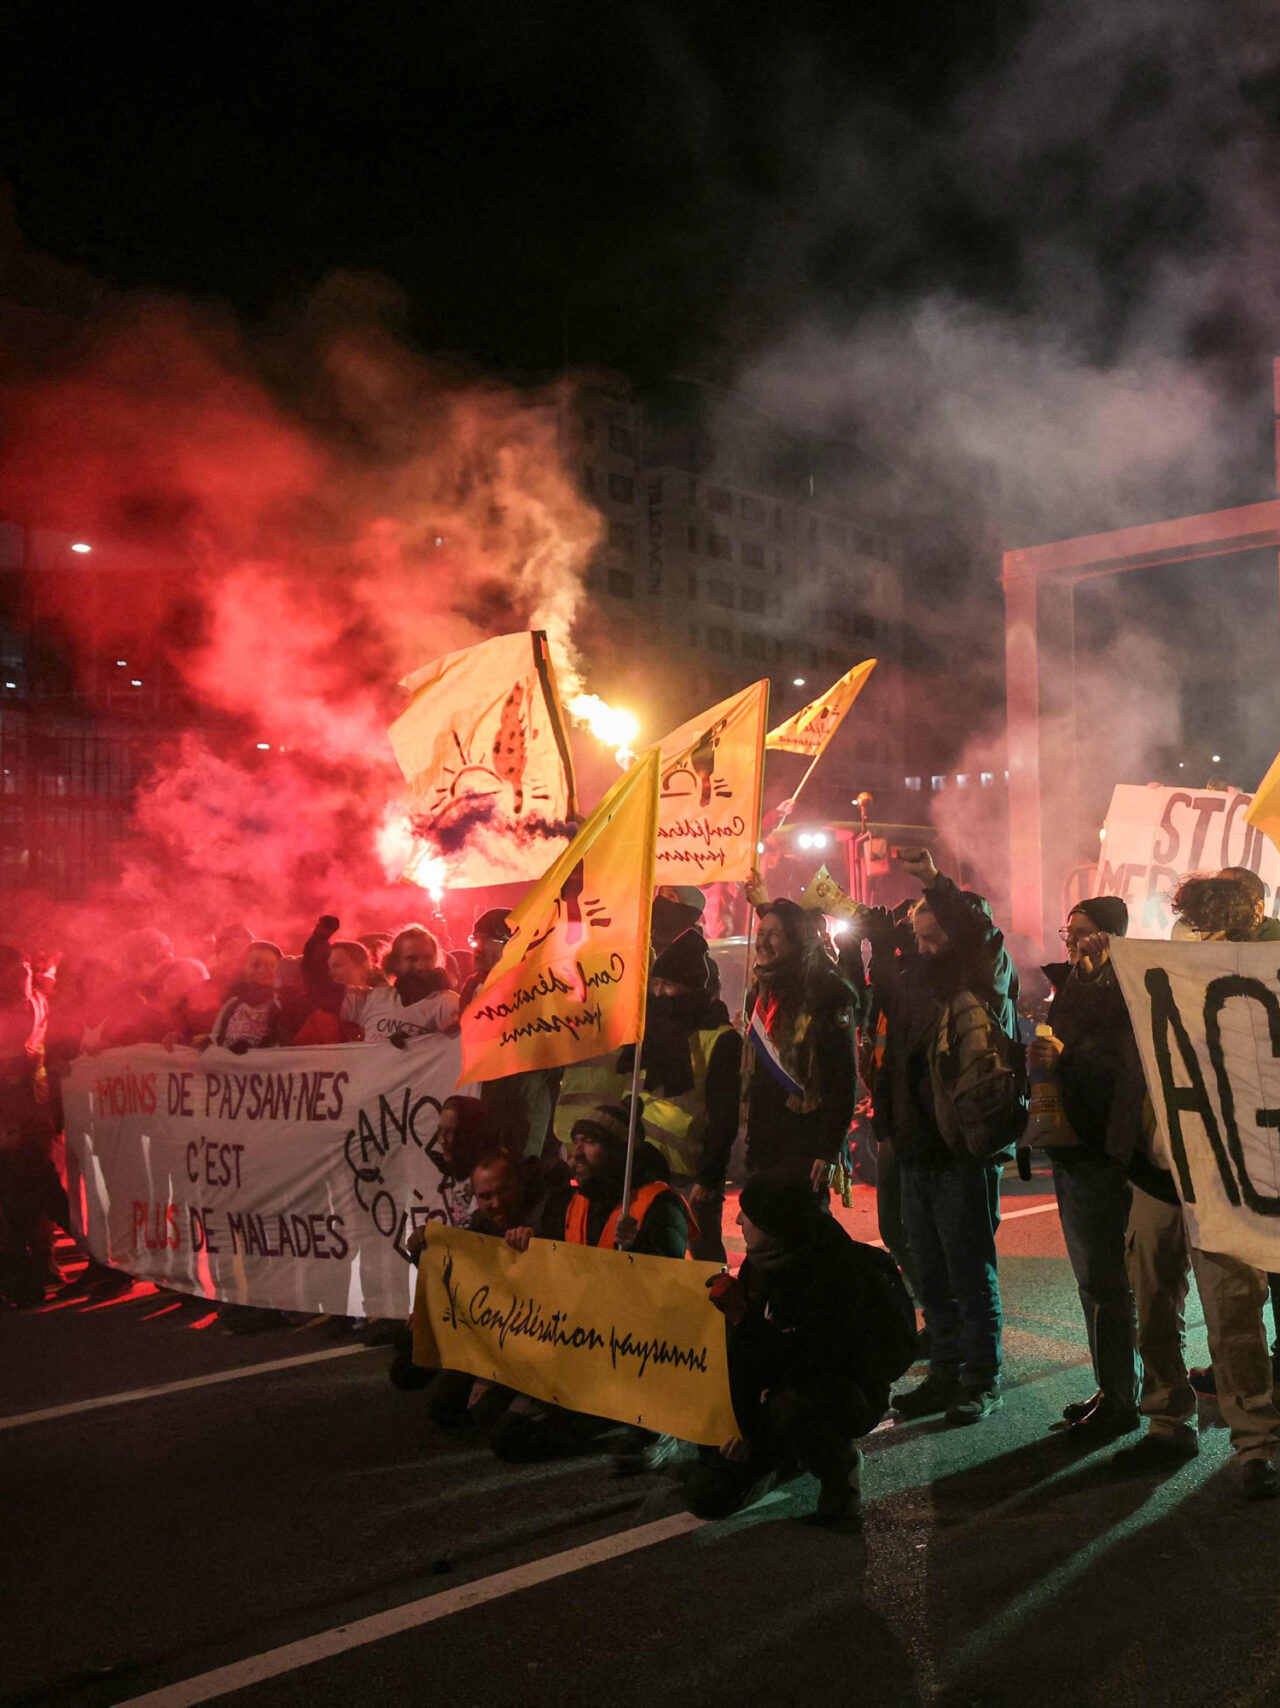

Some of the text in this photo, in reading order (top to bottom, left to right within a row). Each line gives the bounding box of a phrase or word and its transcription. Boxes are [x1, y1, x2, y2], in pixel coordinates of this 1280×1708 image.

[167, 1072, 194, 1117] DE
[187, 1135, 245, 1189] C'EST
[131, 1201, 349, 1260] PLUS DE MALADES
[469, 1285, 708, 1378] Confédération paysanne
